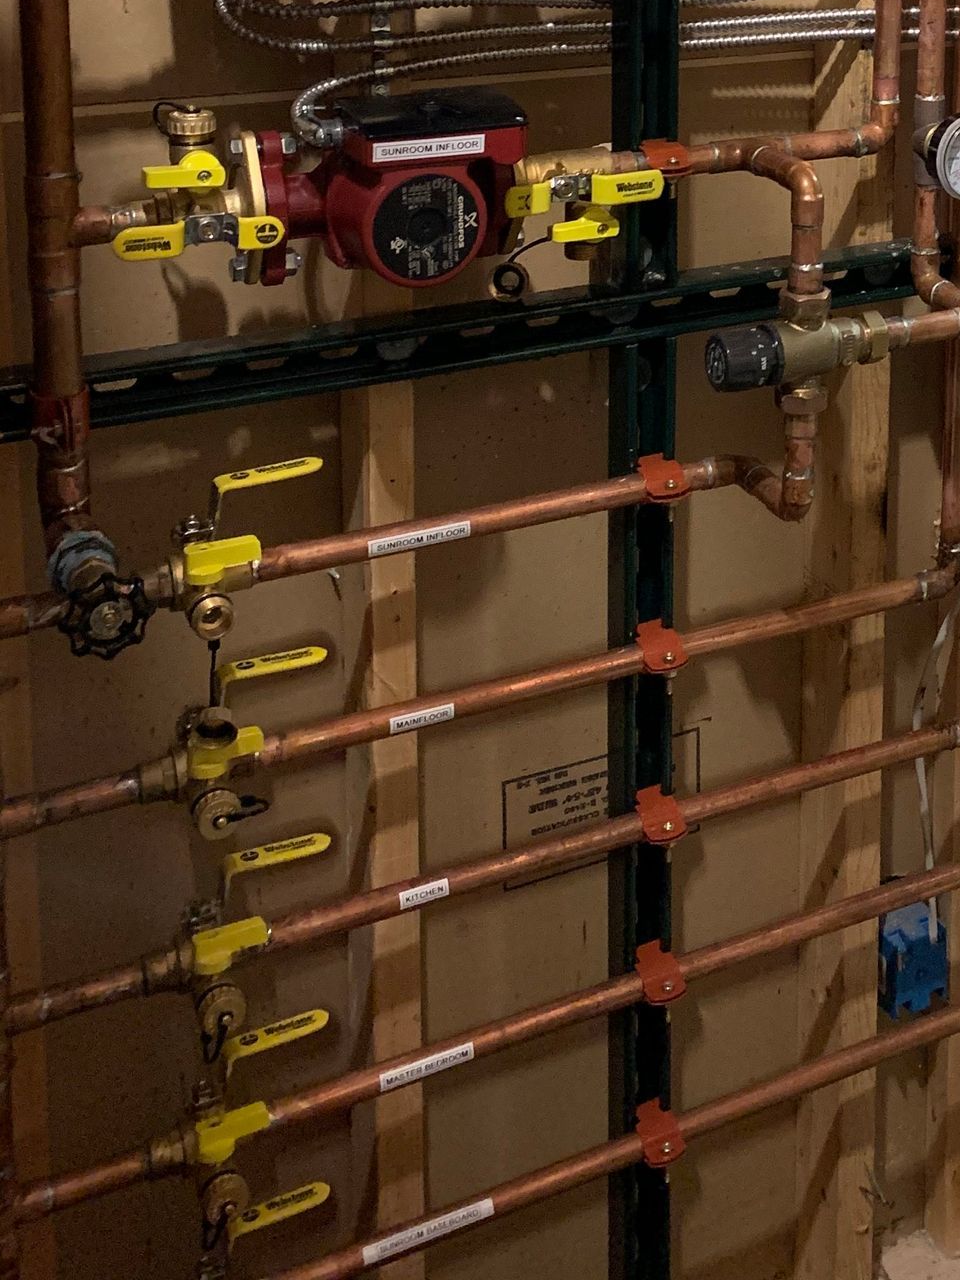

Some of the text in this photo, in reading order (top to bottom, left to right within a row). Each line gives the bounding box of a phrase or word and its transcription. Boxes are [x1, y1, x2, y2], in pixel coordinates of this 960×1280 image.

[381, 140, 479, 156] SUNROOM INFLOOR
[615, 179, 653, 193] Webstone
[457, 196, 465, 248] GRUNDFOS
[123, 240, 172, 253] Webstone
[377, 527, 466, 552] SUNROOM INFLOOR
[396, 710, 449, 729] MAINFLOOR
[405, 886, 444, 903] KITCHEN
[386, 1050, 468, 1084] MASTER BEDROOM
